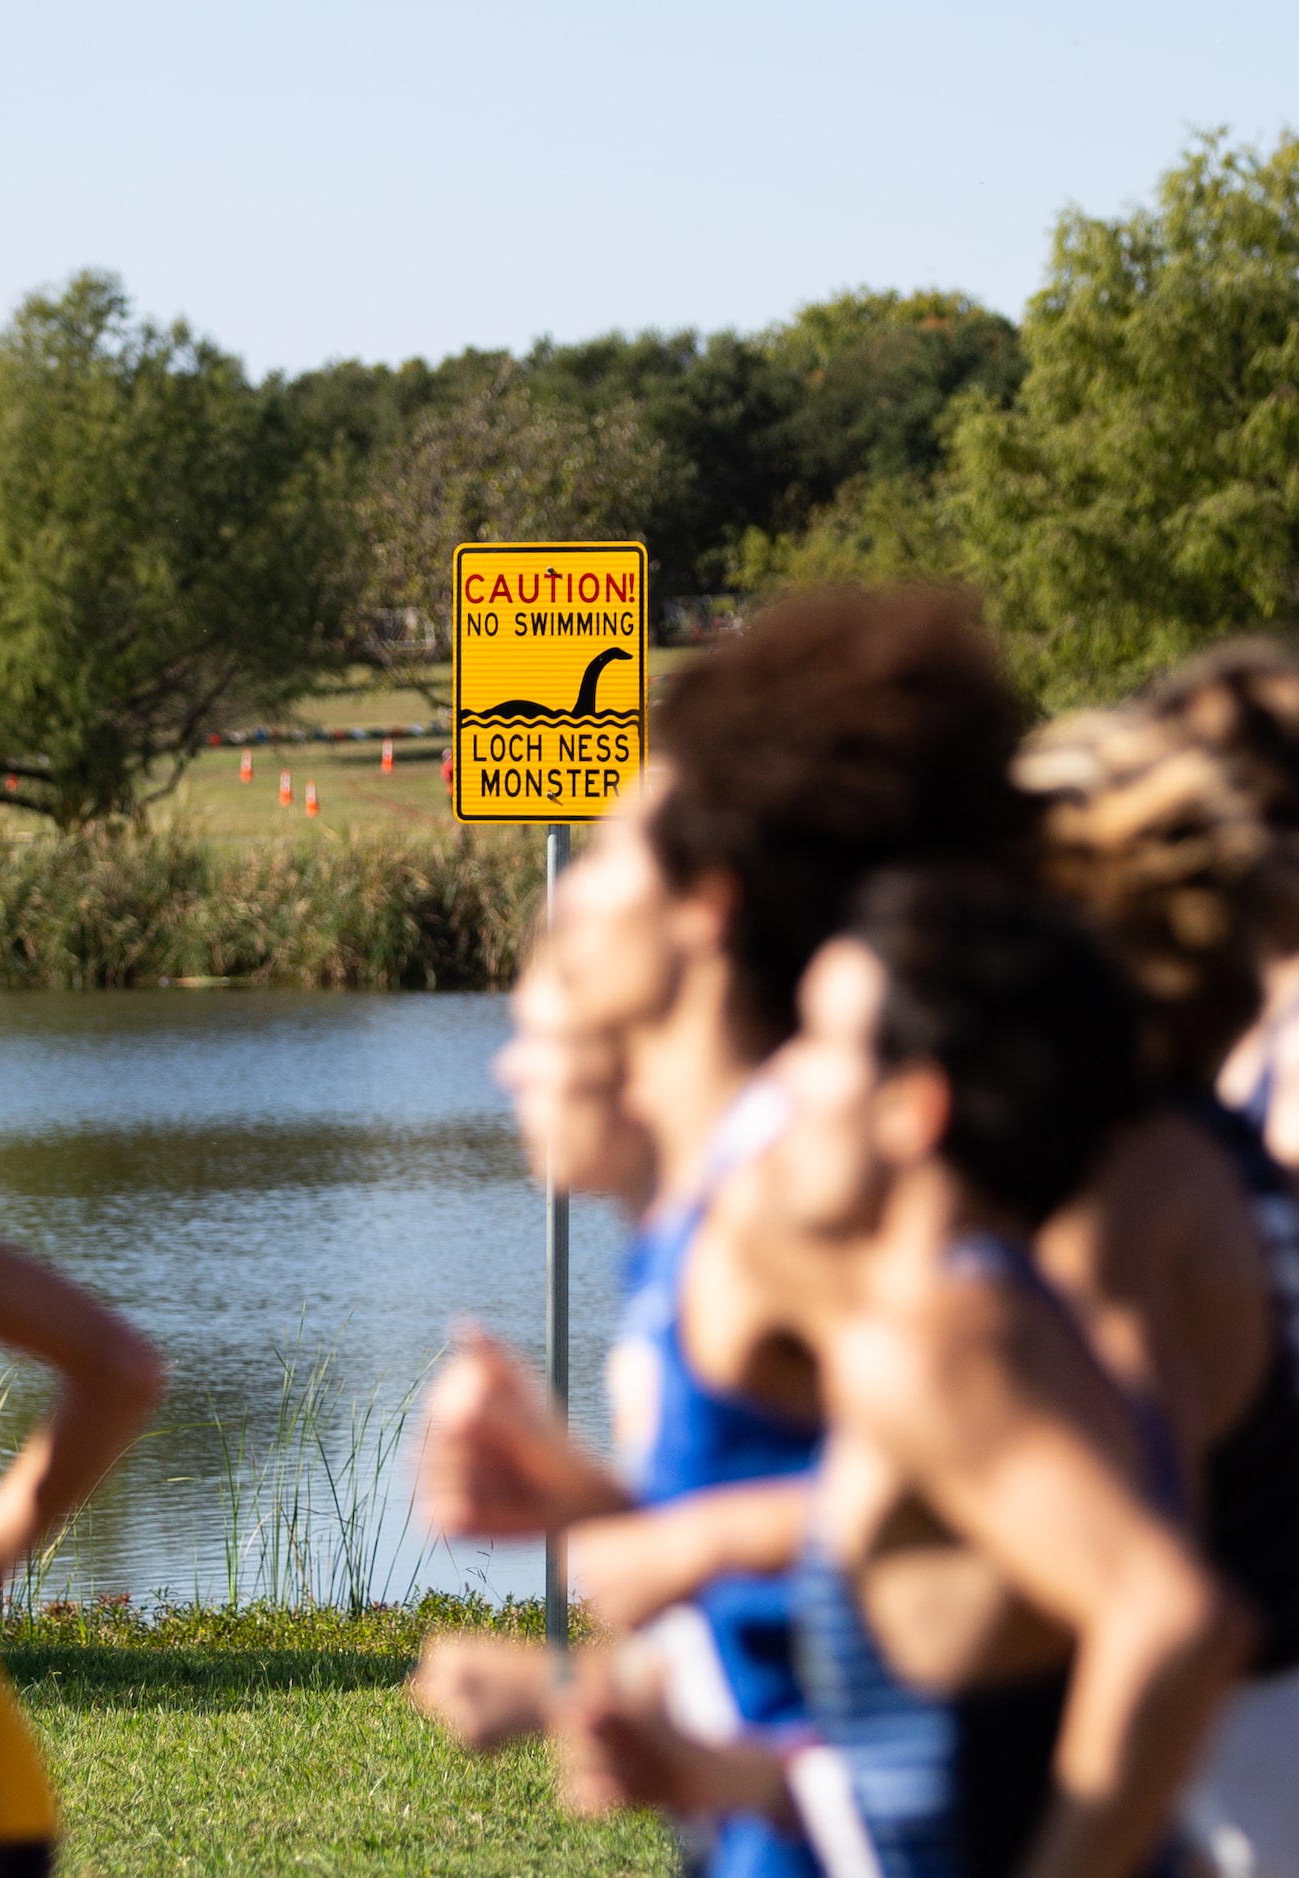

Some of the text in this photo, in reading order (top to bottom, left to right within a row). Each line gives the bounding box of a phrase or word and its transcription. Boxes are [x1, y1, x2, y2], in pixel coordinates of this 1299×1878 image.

[465, 573, 635, 604] CAUTION!
[467, 611, 634, 636] NO SWIMMING
[473, 734, 630, 762] LOCH NESS
[481, 769, 621, 797] MONSTER
